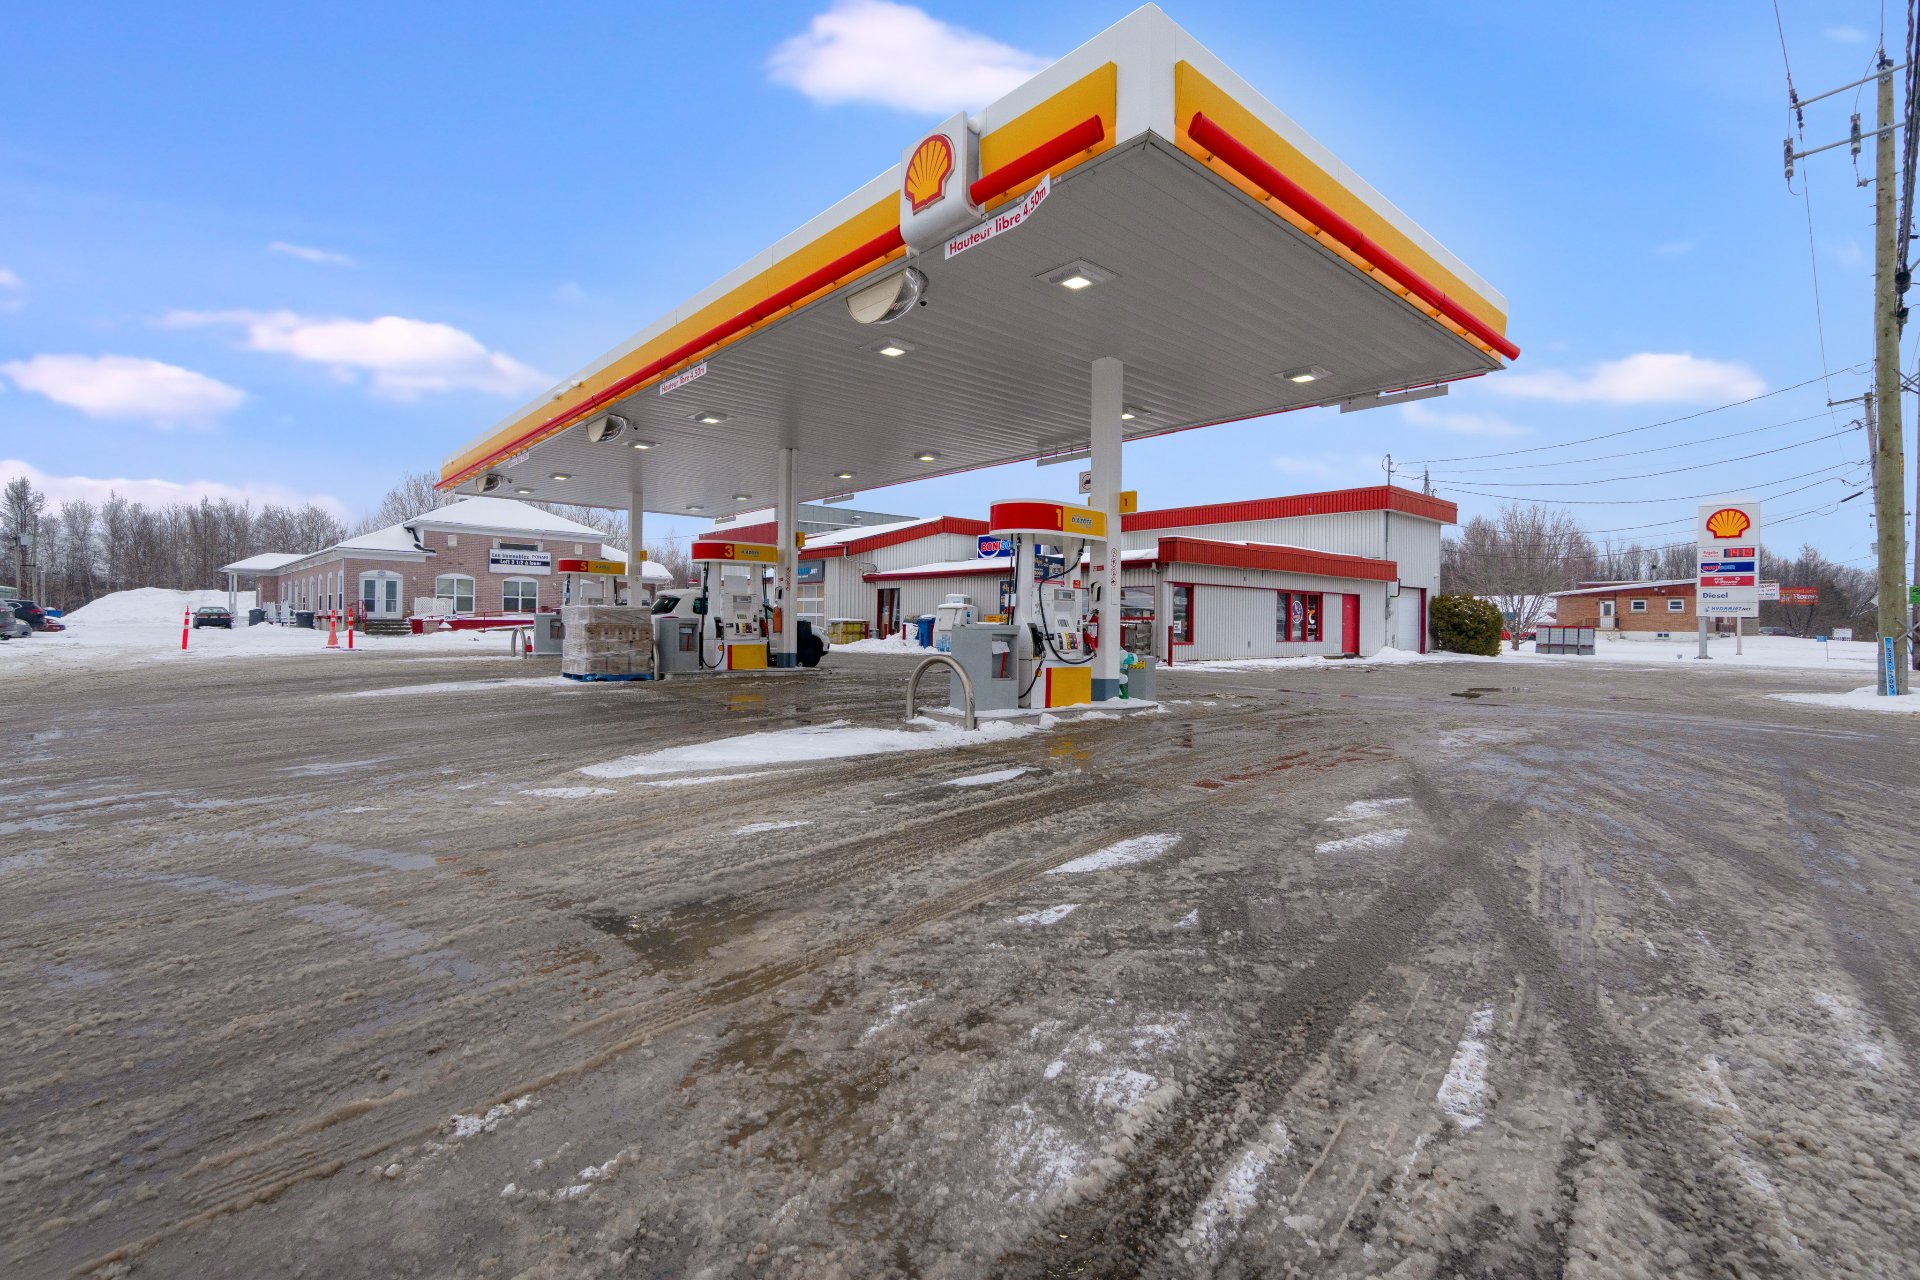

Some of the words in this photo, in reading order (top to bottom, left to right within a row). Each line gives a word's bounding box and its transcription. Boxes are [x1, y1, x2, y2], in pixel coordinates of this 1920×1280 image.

[949, 226, 992, 255] Hauteur
[995, 213, 1021, 233] libre
[1124, 498, 1128, 507] 1
[1056, 508, 1062, 528] 1
[724, 544, 734, 558] 3
[580, 562, 587, 571] 5
